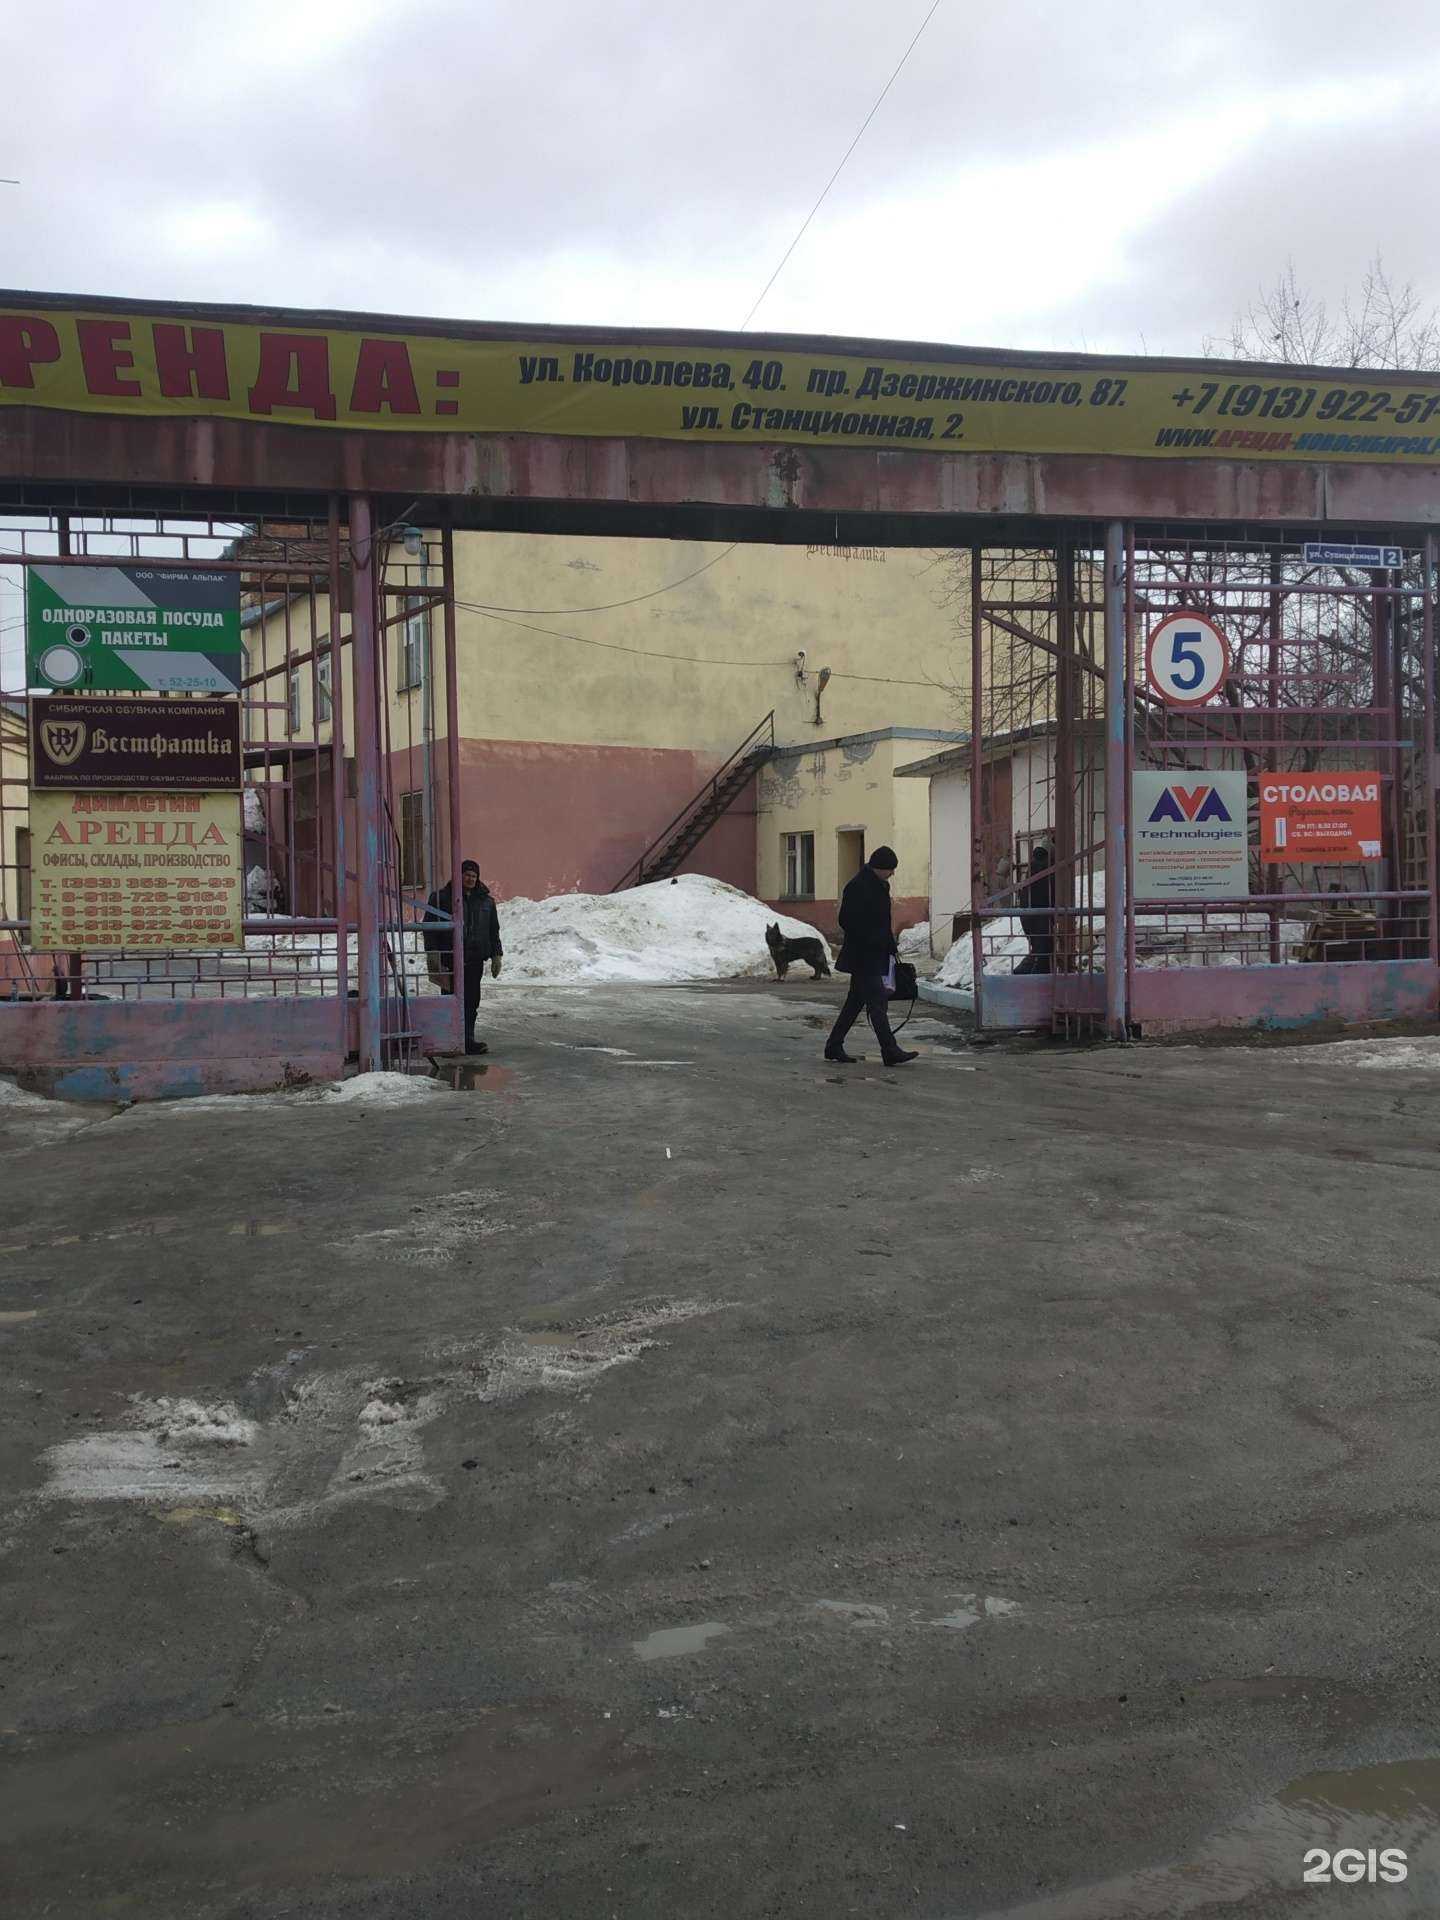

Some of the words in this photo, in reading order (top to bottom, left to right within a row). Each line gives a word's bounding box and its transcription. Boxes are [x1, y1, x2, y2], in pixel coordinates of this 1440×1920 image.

[519, 355, 564, 385] ул.
[572, 353, 736, 391] Королева,
[742, 360, 787, 391] 40.
[806, 366, 850, 397] пр.
[855, 366, 1083, 407] Дзержинского,
[1089, 378, 1128, 406] 87.
[1172, 383, 1219, 415] +7
[1217, 384, 1316, 419] (913)
[680, 405, 722, 430] ул.
[731, 402, 934, 441] Станционная,
[940, 413, 964, 440] 2.
[1387, 551, 1397, 564] 2
[42, 608, 157, 625] ОДНОРАЗОВАЯ
[163, 611, 224, 627] ПОСУДА
[101, 631, 168, 646] ПАКЕТЫ
[1170, 631, 1205, 690] 5
[48, 704, 113, 714] СИБИРСКАЯ
[115, 705, 166, 714] ОБУВНАЯ
[168, 706, 225, 715] КОМПАНИЯ
[90, 728, 232, 759] Вестфалика
[72, 793, 201, 814] ДИНАСТИЯ
[1147, 785, 1233, 822] AVA
[1263, 784, 1378, 802] СТОЛОВАЯ
[44, 820, 229, 851] АРЕНДА
[1138, 829, 1243, 840] Technologies
[43, 853, 88, 868] ОФИСЫ,
[90, 854, 141, 869] СКЛАДЫ,
[144, 854, 231, 869] ПРОИЗВОДСТВО
